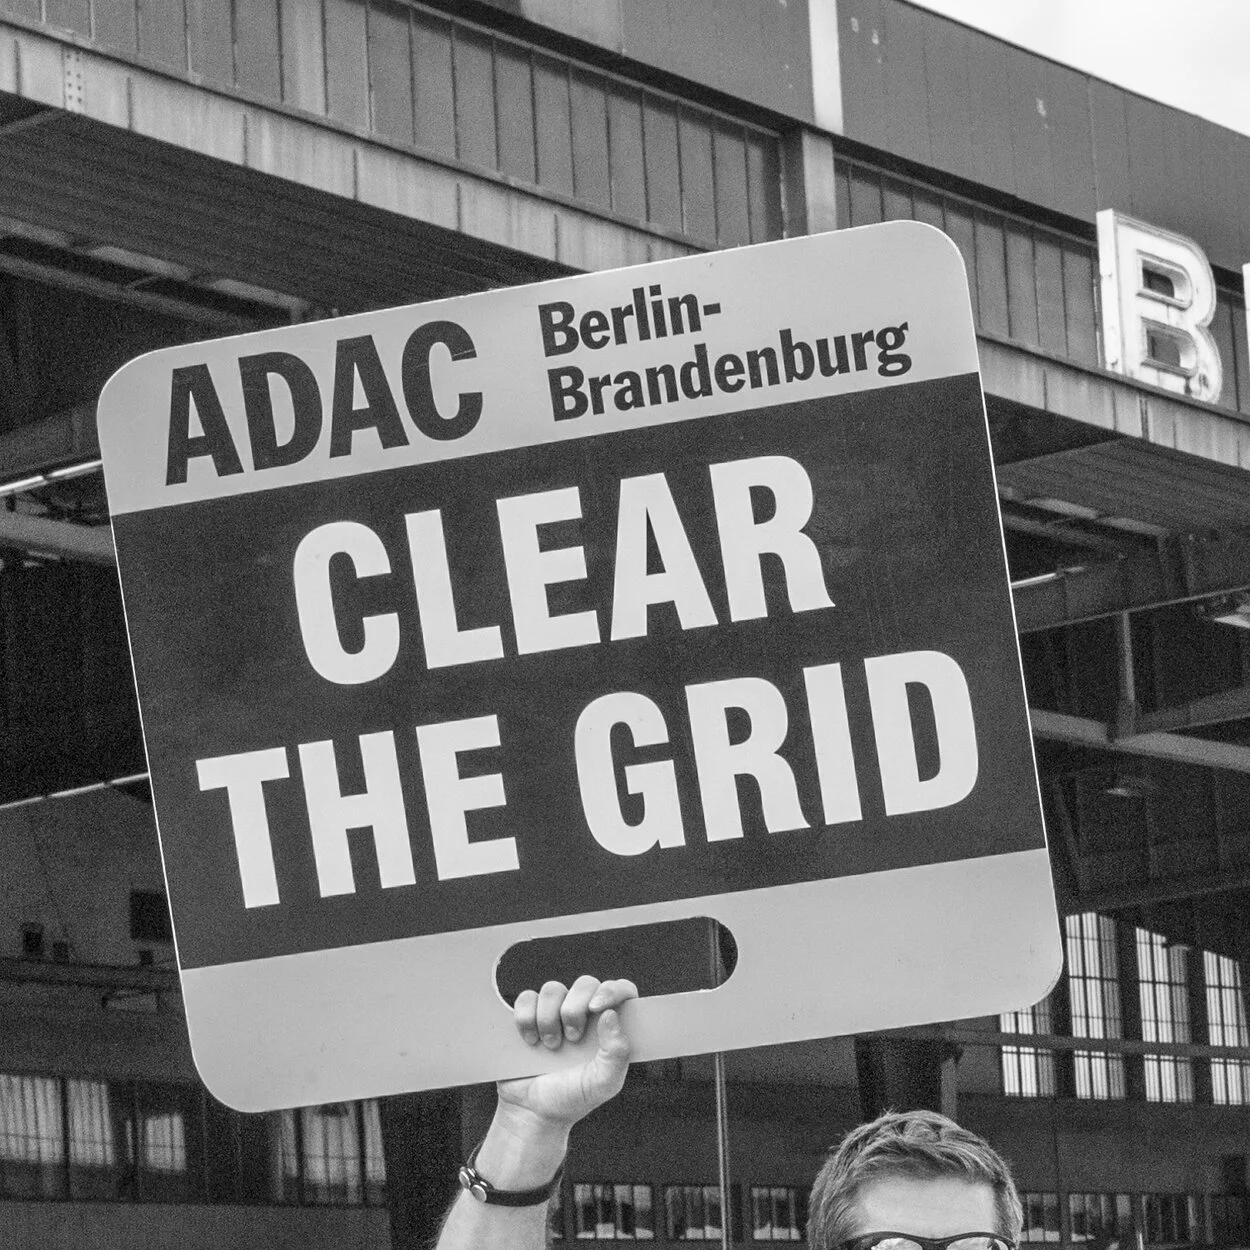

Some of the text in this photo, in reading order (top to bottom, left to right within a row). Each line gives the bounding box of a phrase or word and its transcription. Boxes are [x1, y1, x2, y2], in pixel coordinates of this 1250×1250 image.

[164, 320, 484, 488] ADAC
[538, 284, 722, 357] Berlin-
[550, 321, 913, 423] Brandenburg
[292, 455, 837, 686] CLEAR
[195, 650, 980, 910] THE GRID
